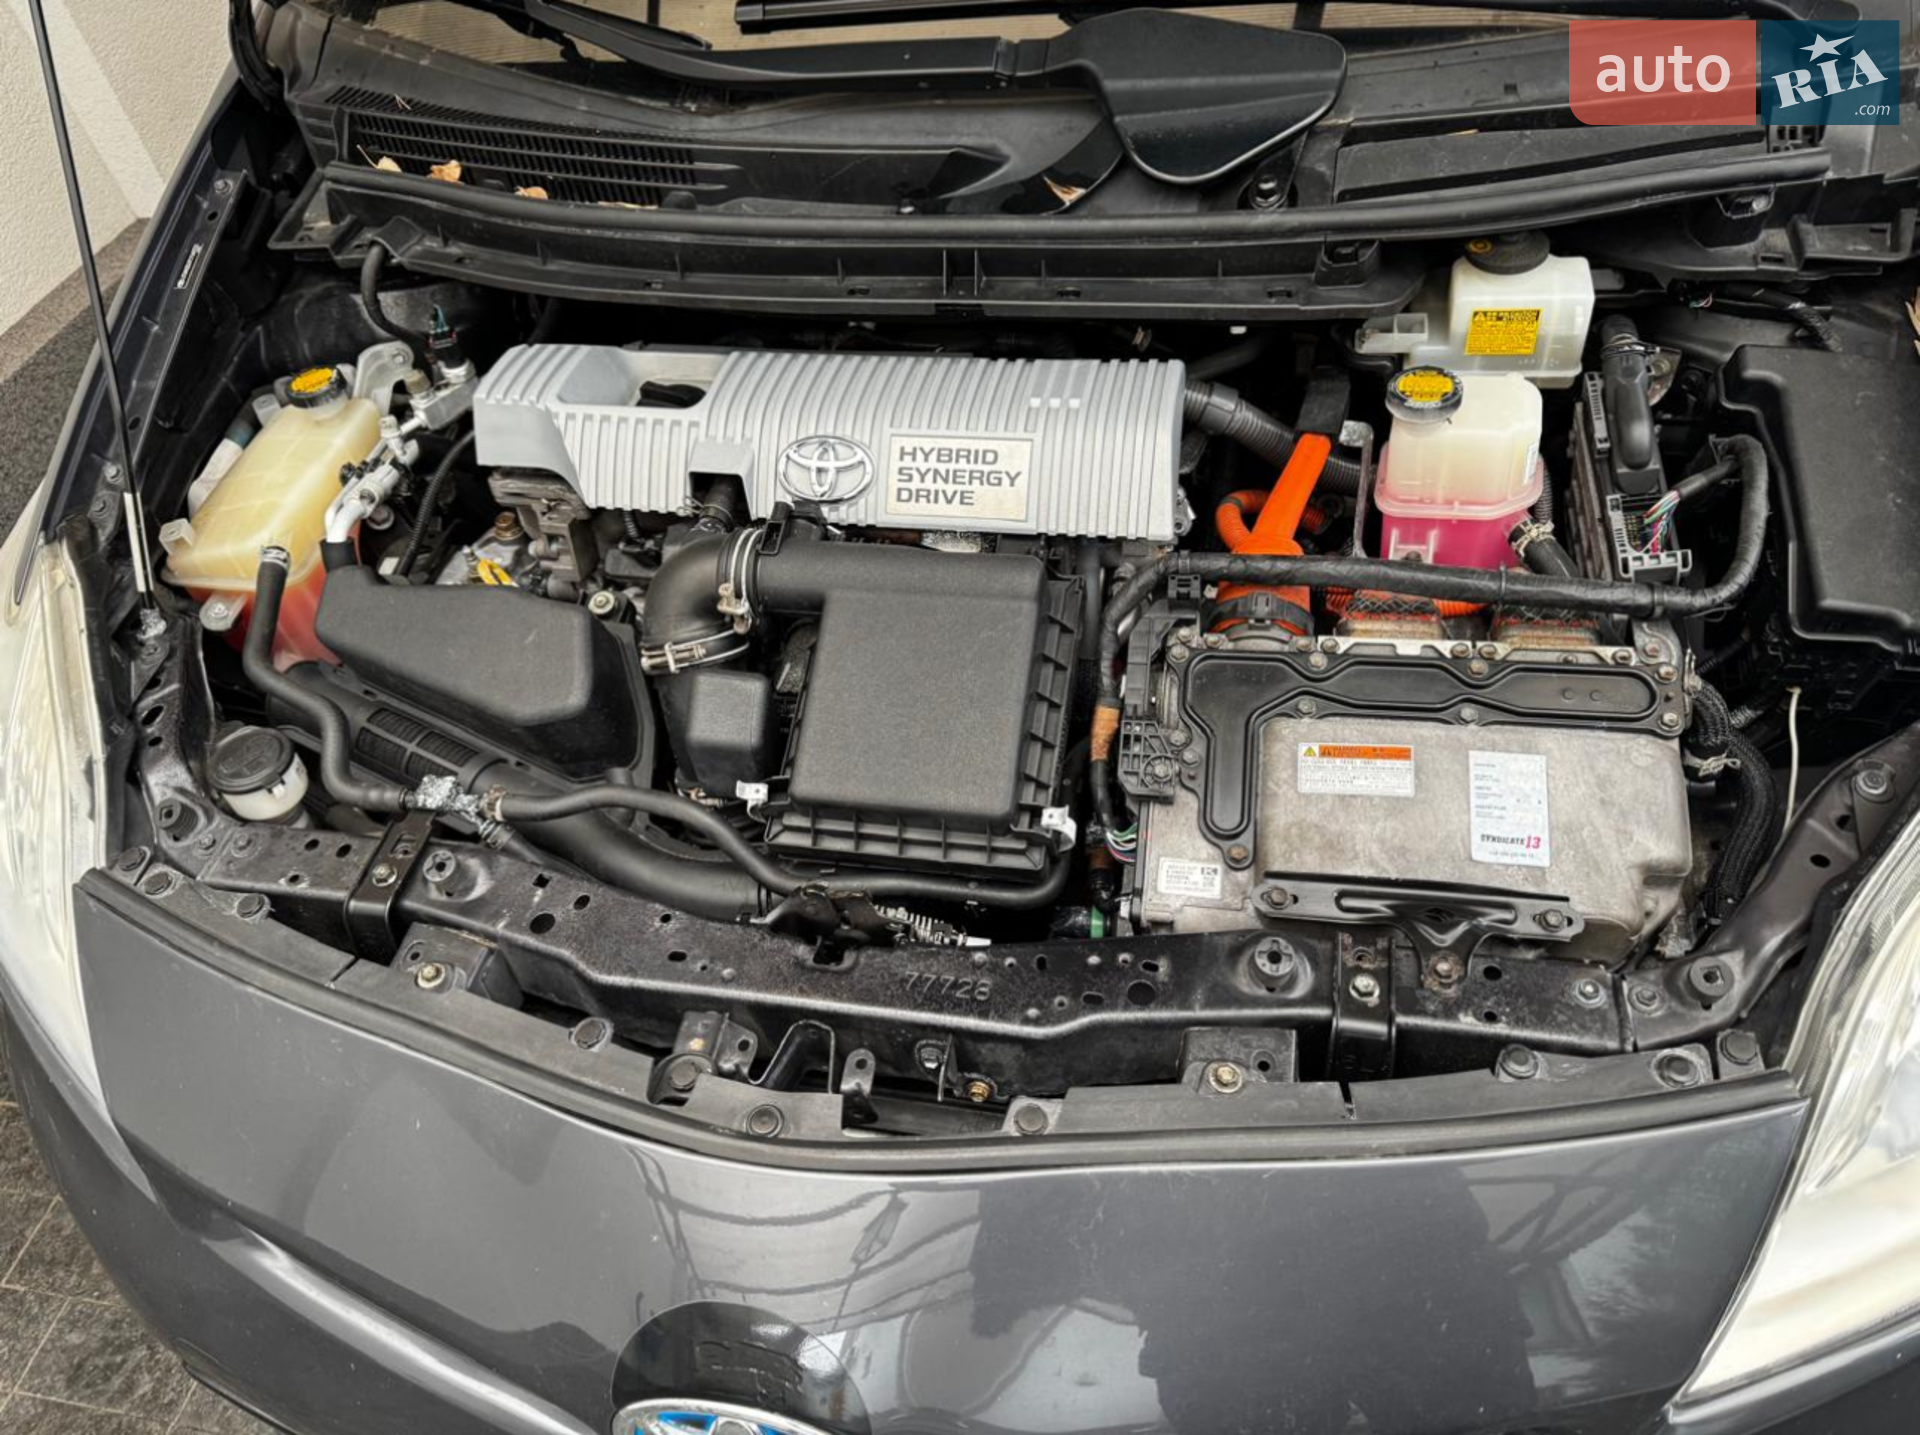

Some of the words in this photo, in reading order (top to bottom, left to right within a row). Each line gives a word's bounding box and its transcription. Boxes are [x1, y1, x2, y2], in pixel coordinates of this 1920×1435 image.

[899, 446, 999, 465] HYBRID
[897, 467, 1021, 487] SYNERGY
[896, 487, 975, 506] DRIVE
[905, 971, 993, 1001] 77728
